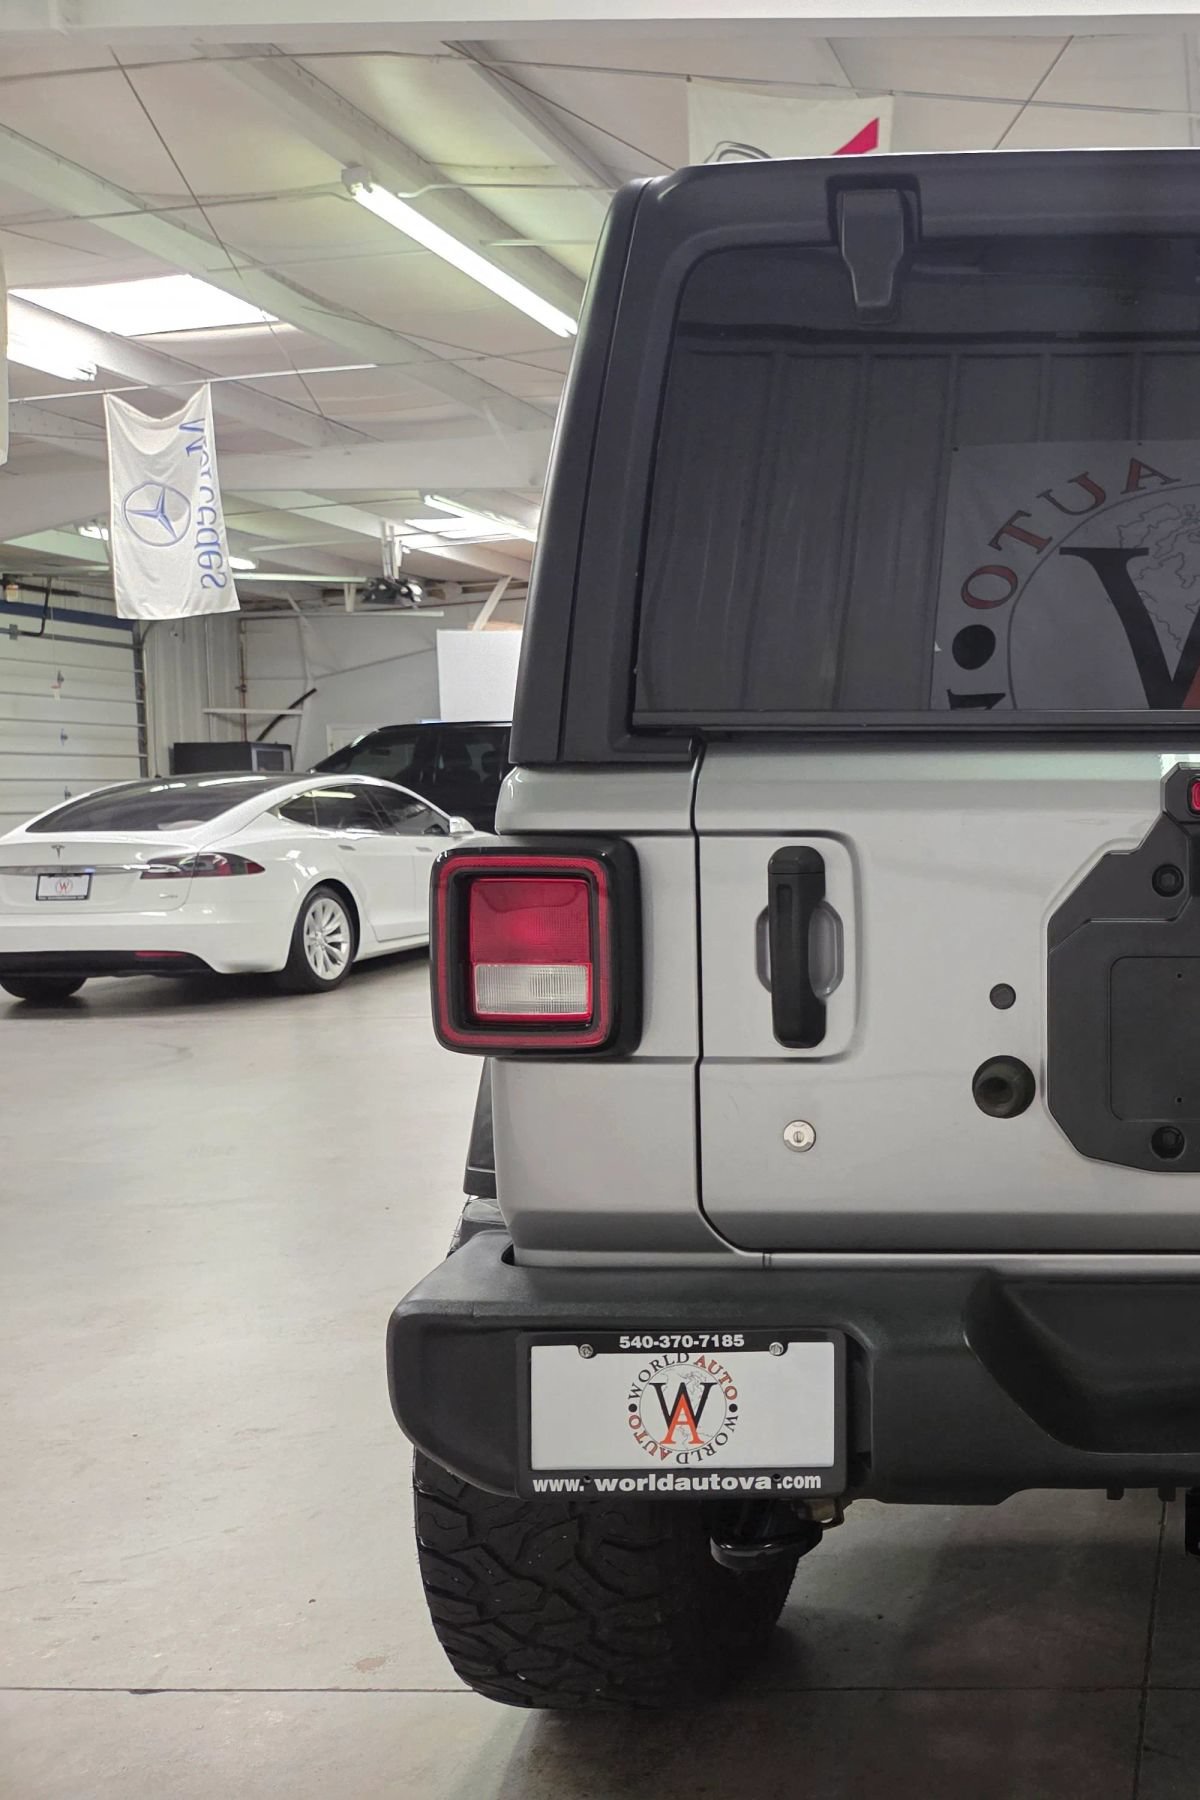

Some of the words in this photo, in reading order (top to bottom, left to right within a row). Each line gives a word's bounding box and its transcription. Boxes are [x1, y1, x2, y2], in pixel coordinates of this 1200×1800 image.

[619, 1334, 745, 1348] 540-370-7185
[628, 1353, 690, 1400] WORLD
[693, 1354, 738, 1400] AUTO
[628, 1414, 672, 1461] AUTO
[675, 1415, 739, 1465] WORLD
